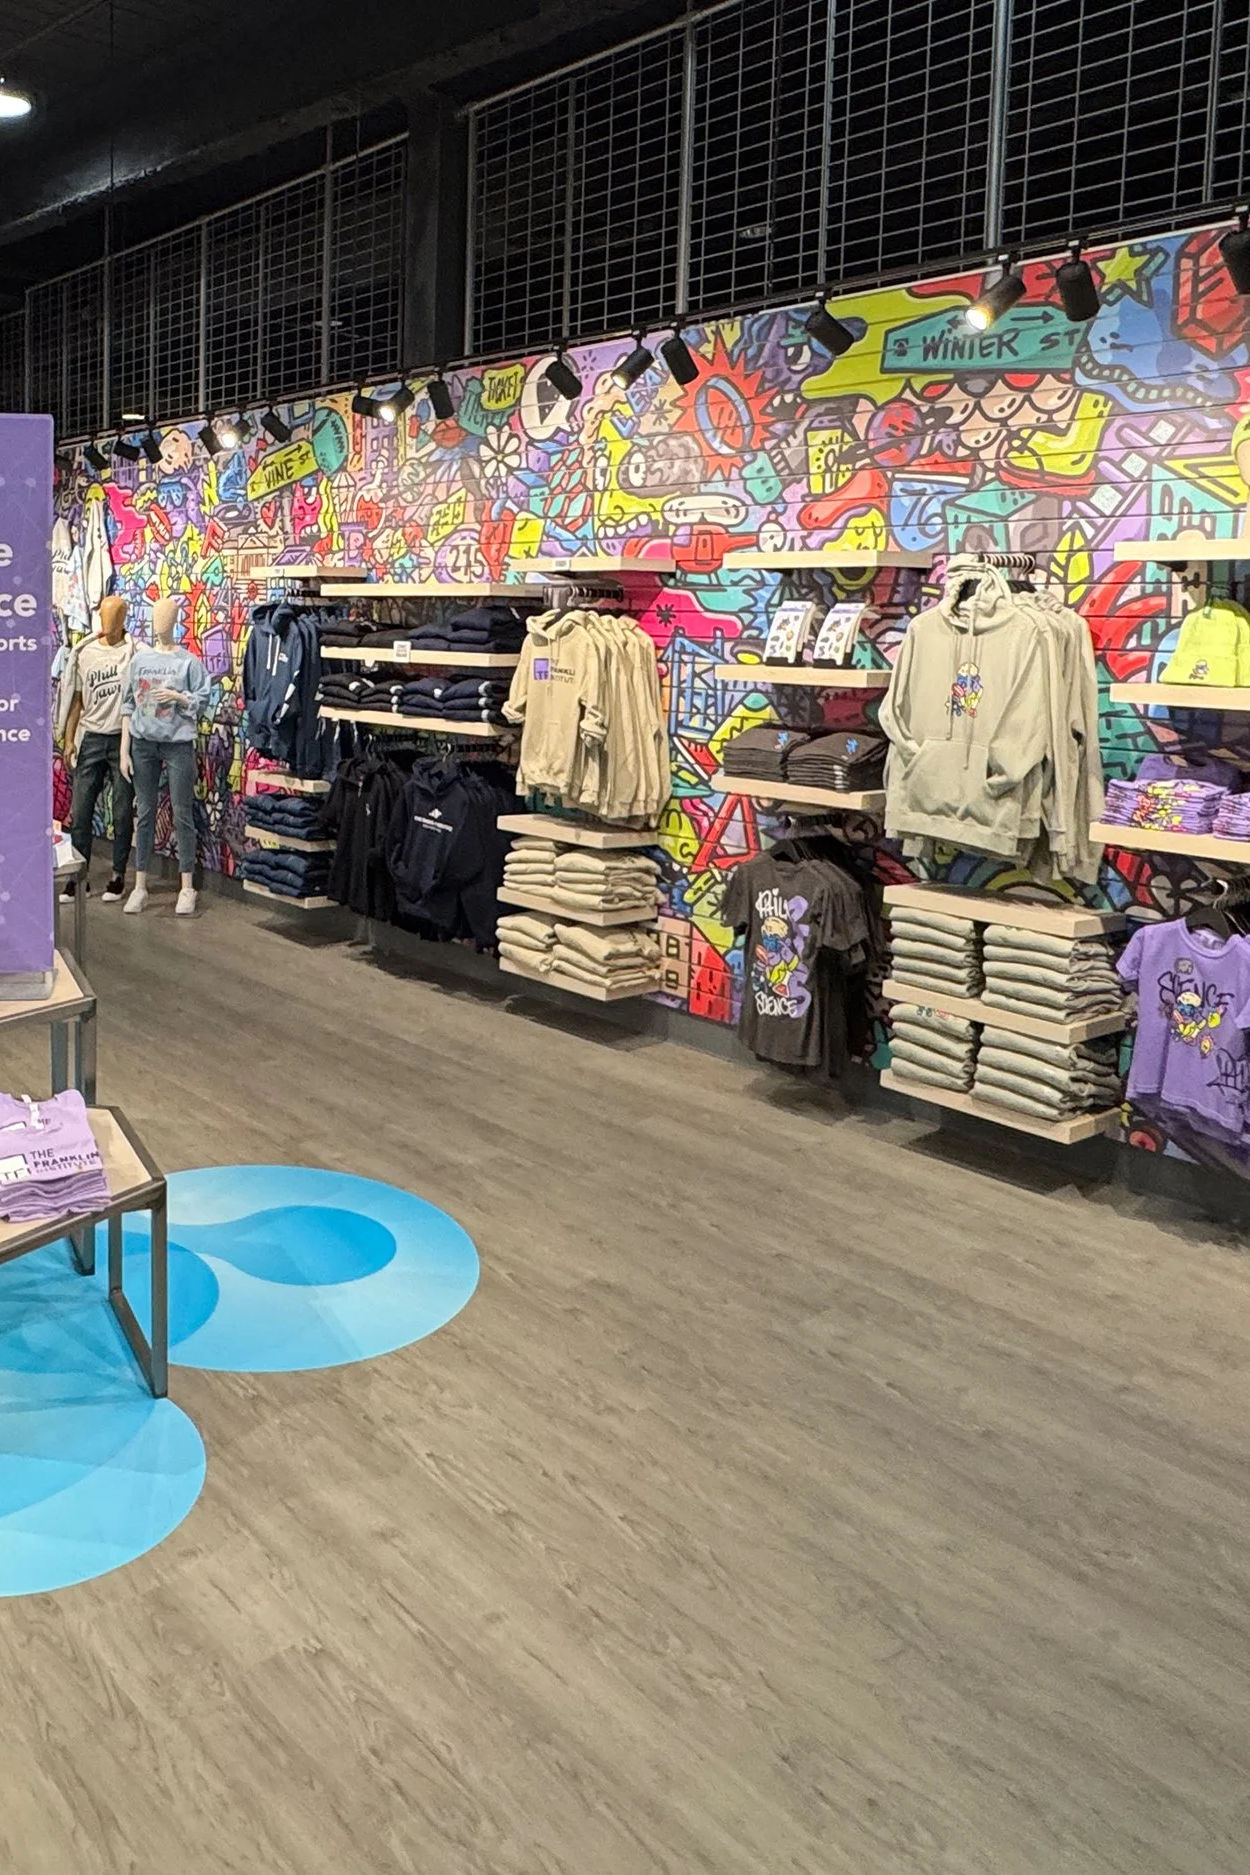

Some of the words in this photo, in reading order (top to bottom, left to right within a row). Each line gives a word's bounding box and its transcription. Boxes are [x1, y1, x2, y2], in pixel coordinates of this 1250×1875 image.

[921, 326, 1019, 362] WINTER
[1039, 328, 1081, 351] ST
[264, 462, 294, 489] VINE
[449, 544, 486, 579] 215
[30, 1148, 55, 1160] THE
[33, 1151, 100, 1168] FRANKLIN
